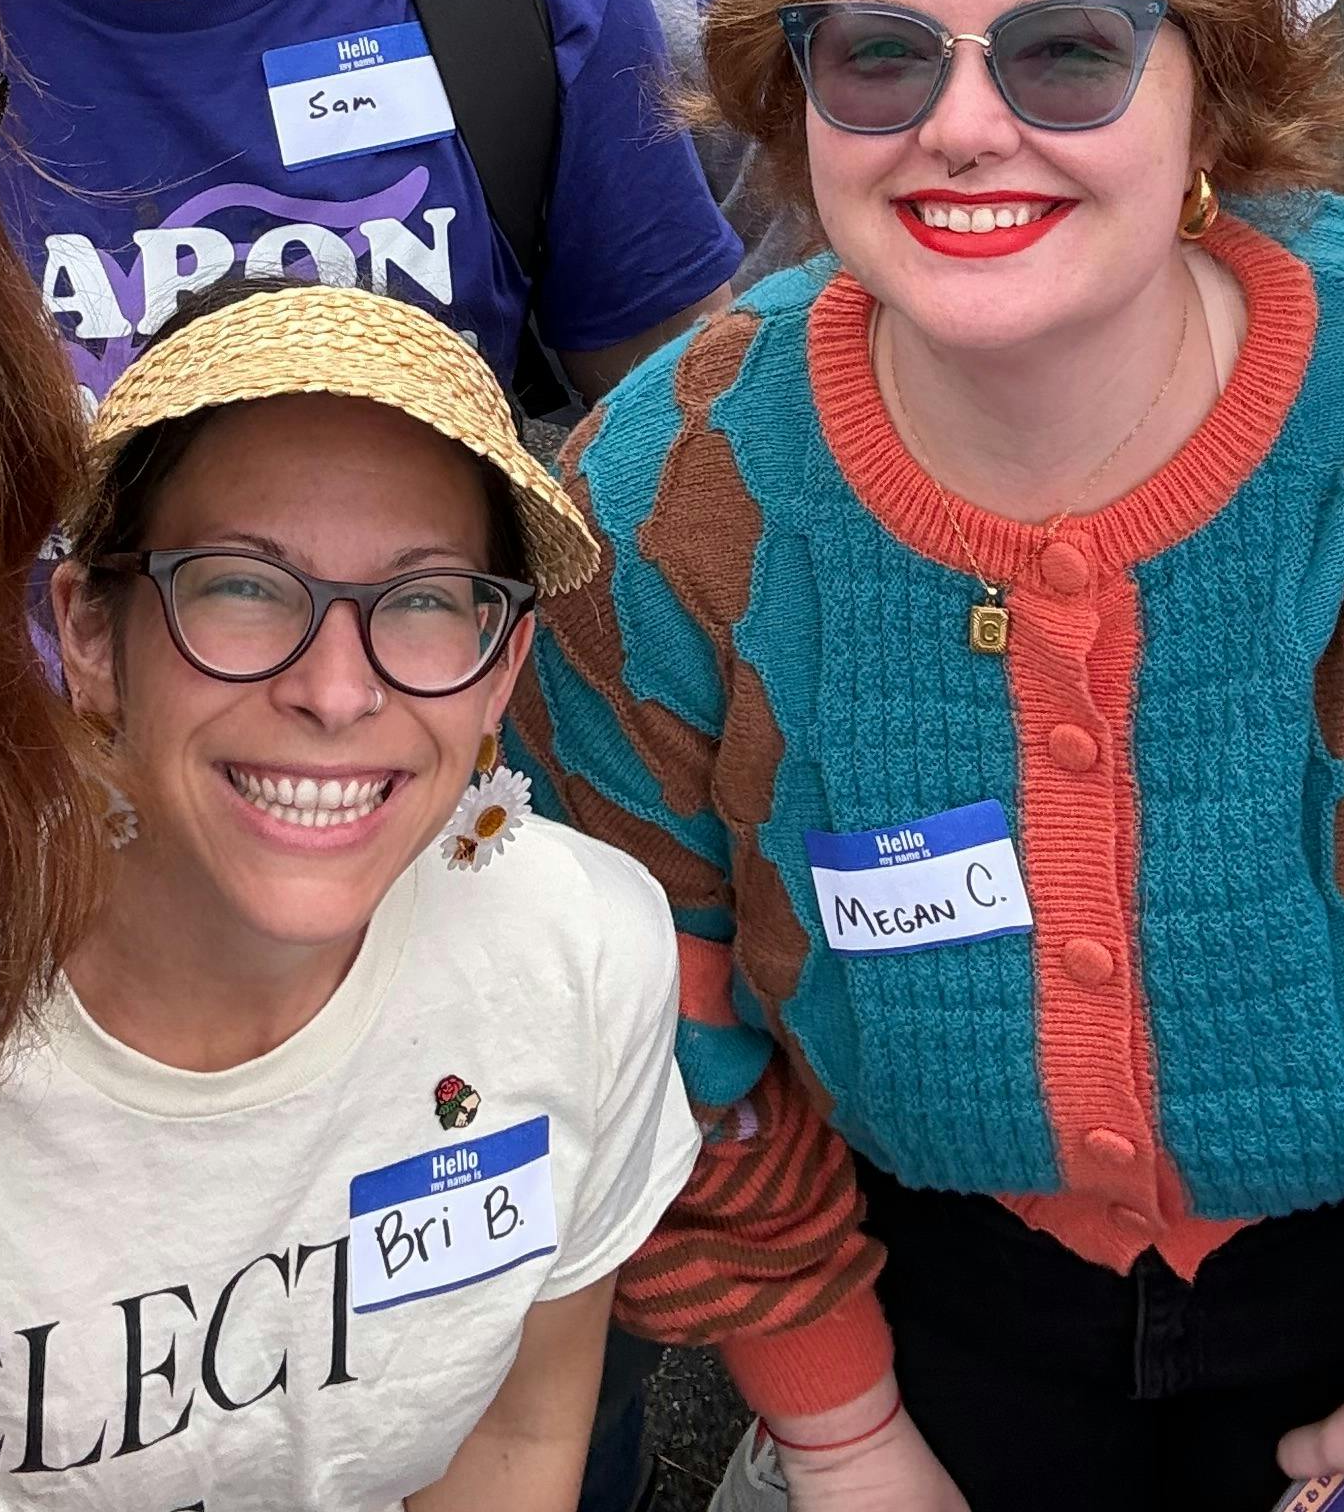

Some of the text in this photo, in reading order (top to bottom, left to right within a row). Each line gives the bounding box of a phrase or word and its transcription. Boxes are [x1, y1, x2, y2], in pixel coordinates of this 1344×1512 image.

[337, 36, 380, 61] Hello
[308, 90, 377, 120] Sam
[42, 206, 456, 340] ARON
[874, 829, 925, 855] Hello
[878, 847, 932, 866] my name is
[965, 861, 1007, 907] C.
[432, 1148, 479, 1179] Hello
[430, 1169, 482, 1193] my name is
[374, 1185, 525, 1280] Bri B.
